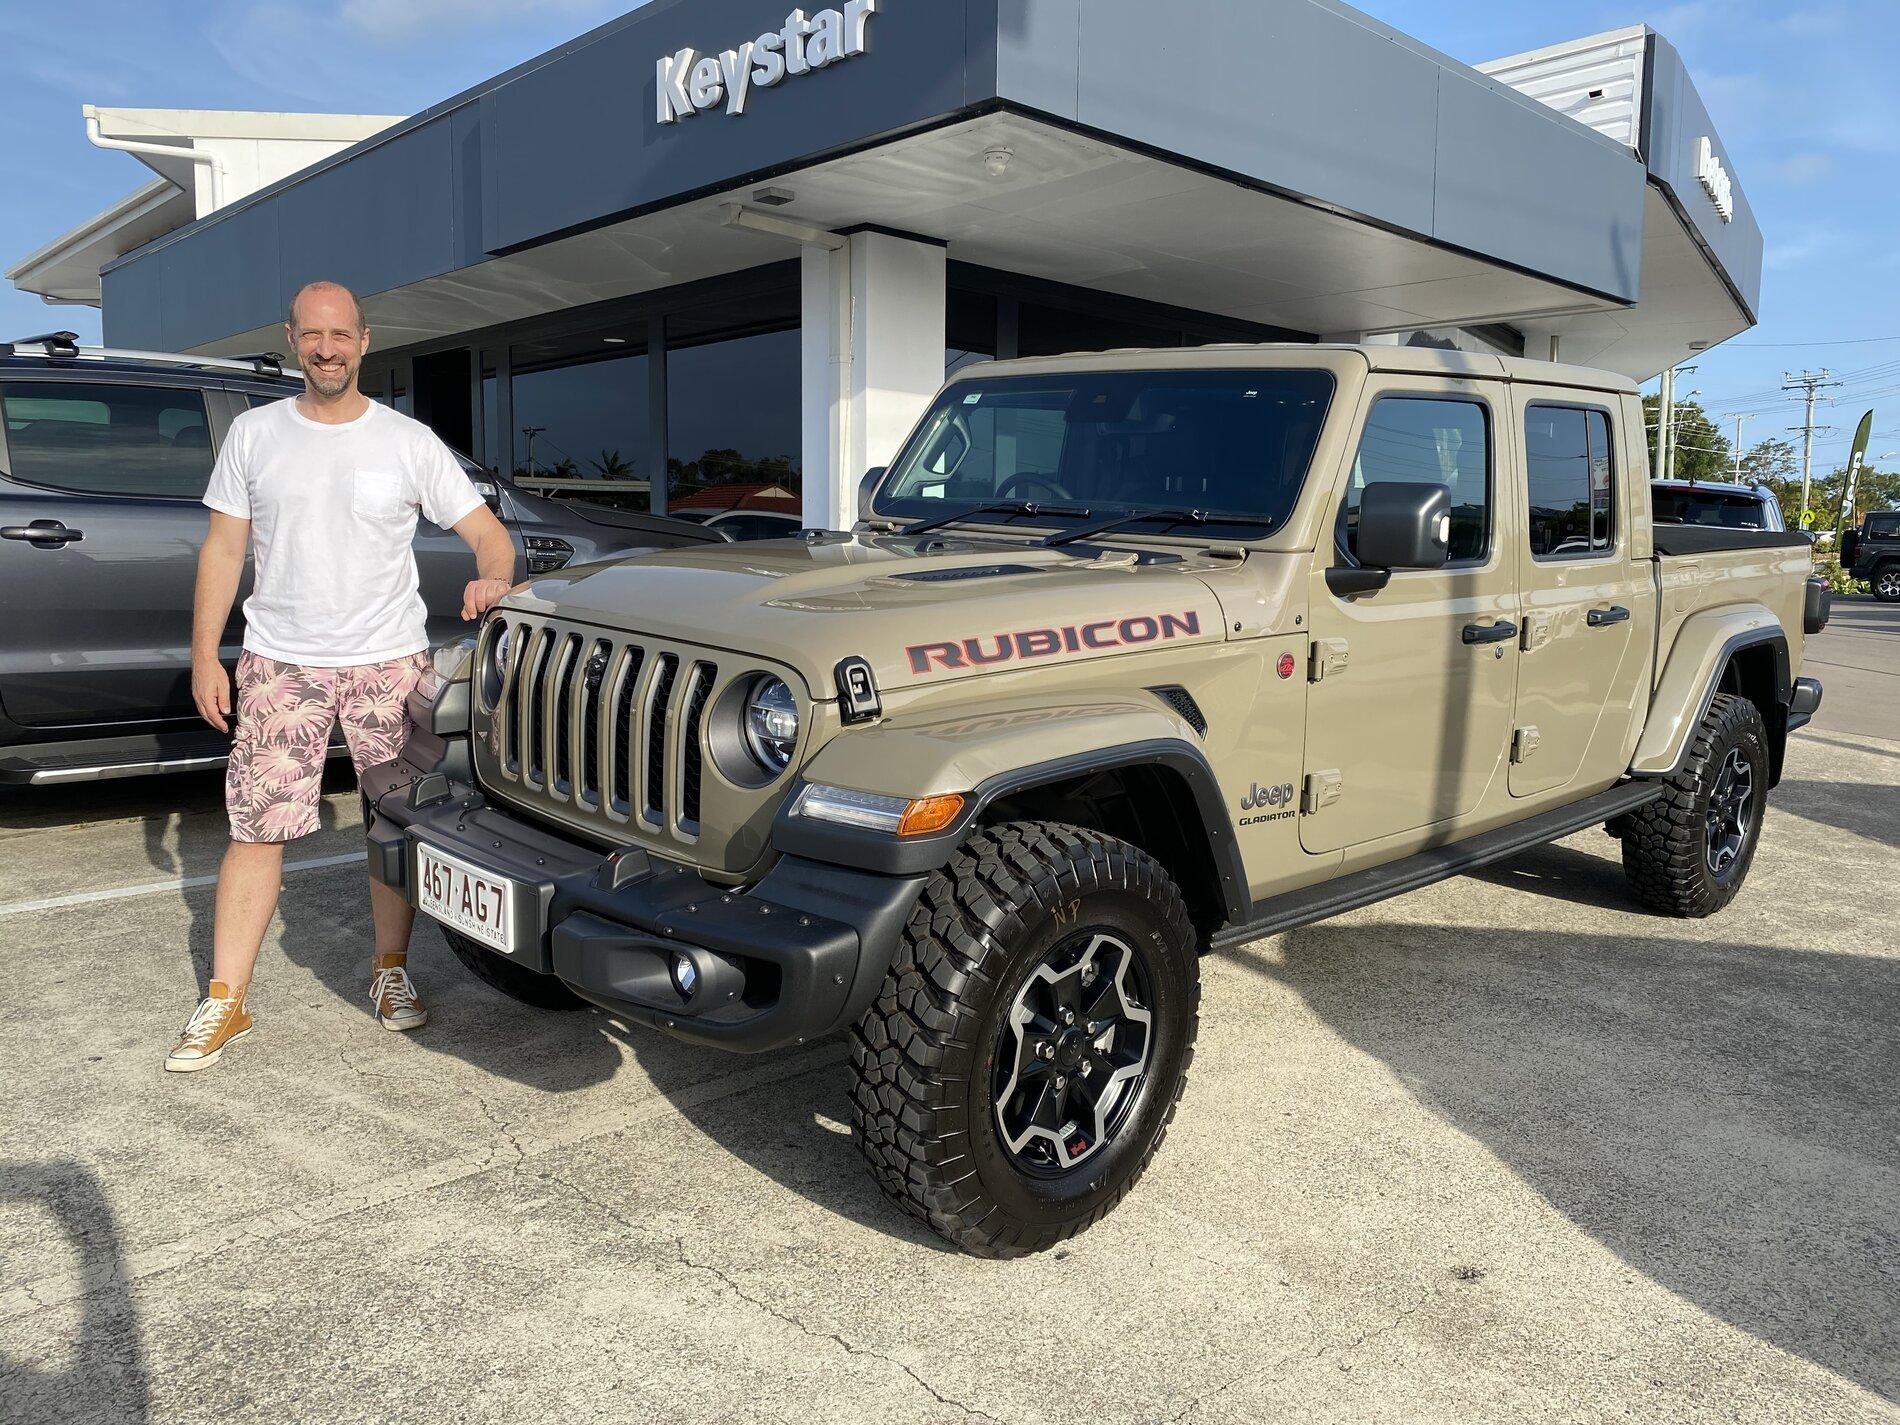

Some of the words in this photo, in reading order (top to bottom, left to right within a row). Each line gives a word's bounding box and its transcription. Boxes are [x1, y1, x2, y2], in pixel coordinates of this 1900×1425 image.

[656, 0, 875, 124] Keystar
[905, 610, 1201, 675] RUBICON
[1239, 810, 1296, 826] GLADIATOR
[1240, 782, 1294, 810] Jeep
[423, 857, 453, 907] 467
[461, 874, 504, 929] AG7
[457, 914, 485, 935] SUNSHINE
[486, 927, 505, 943] STATE
